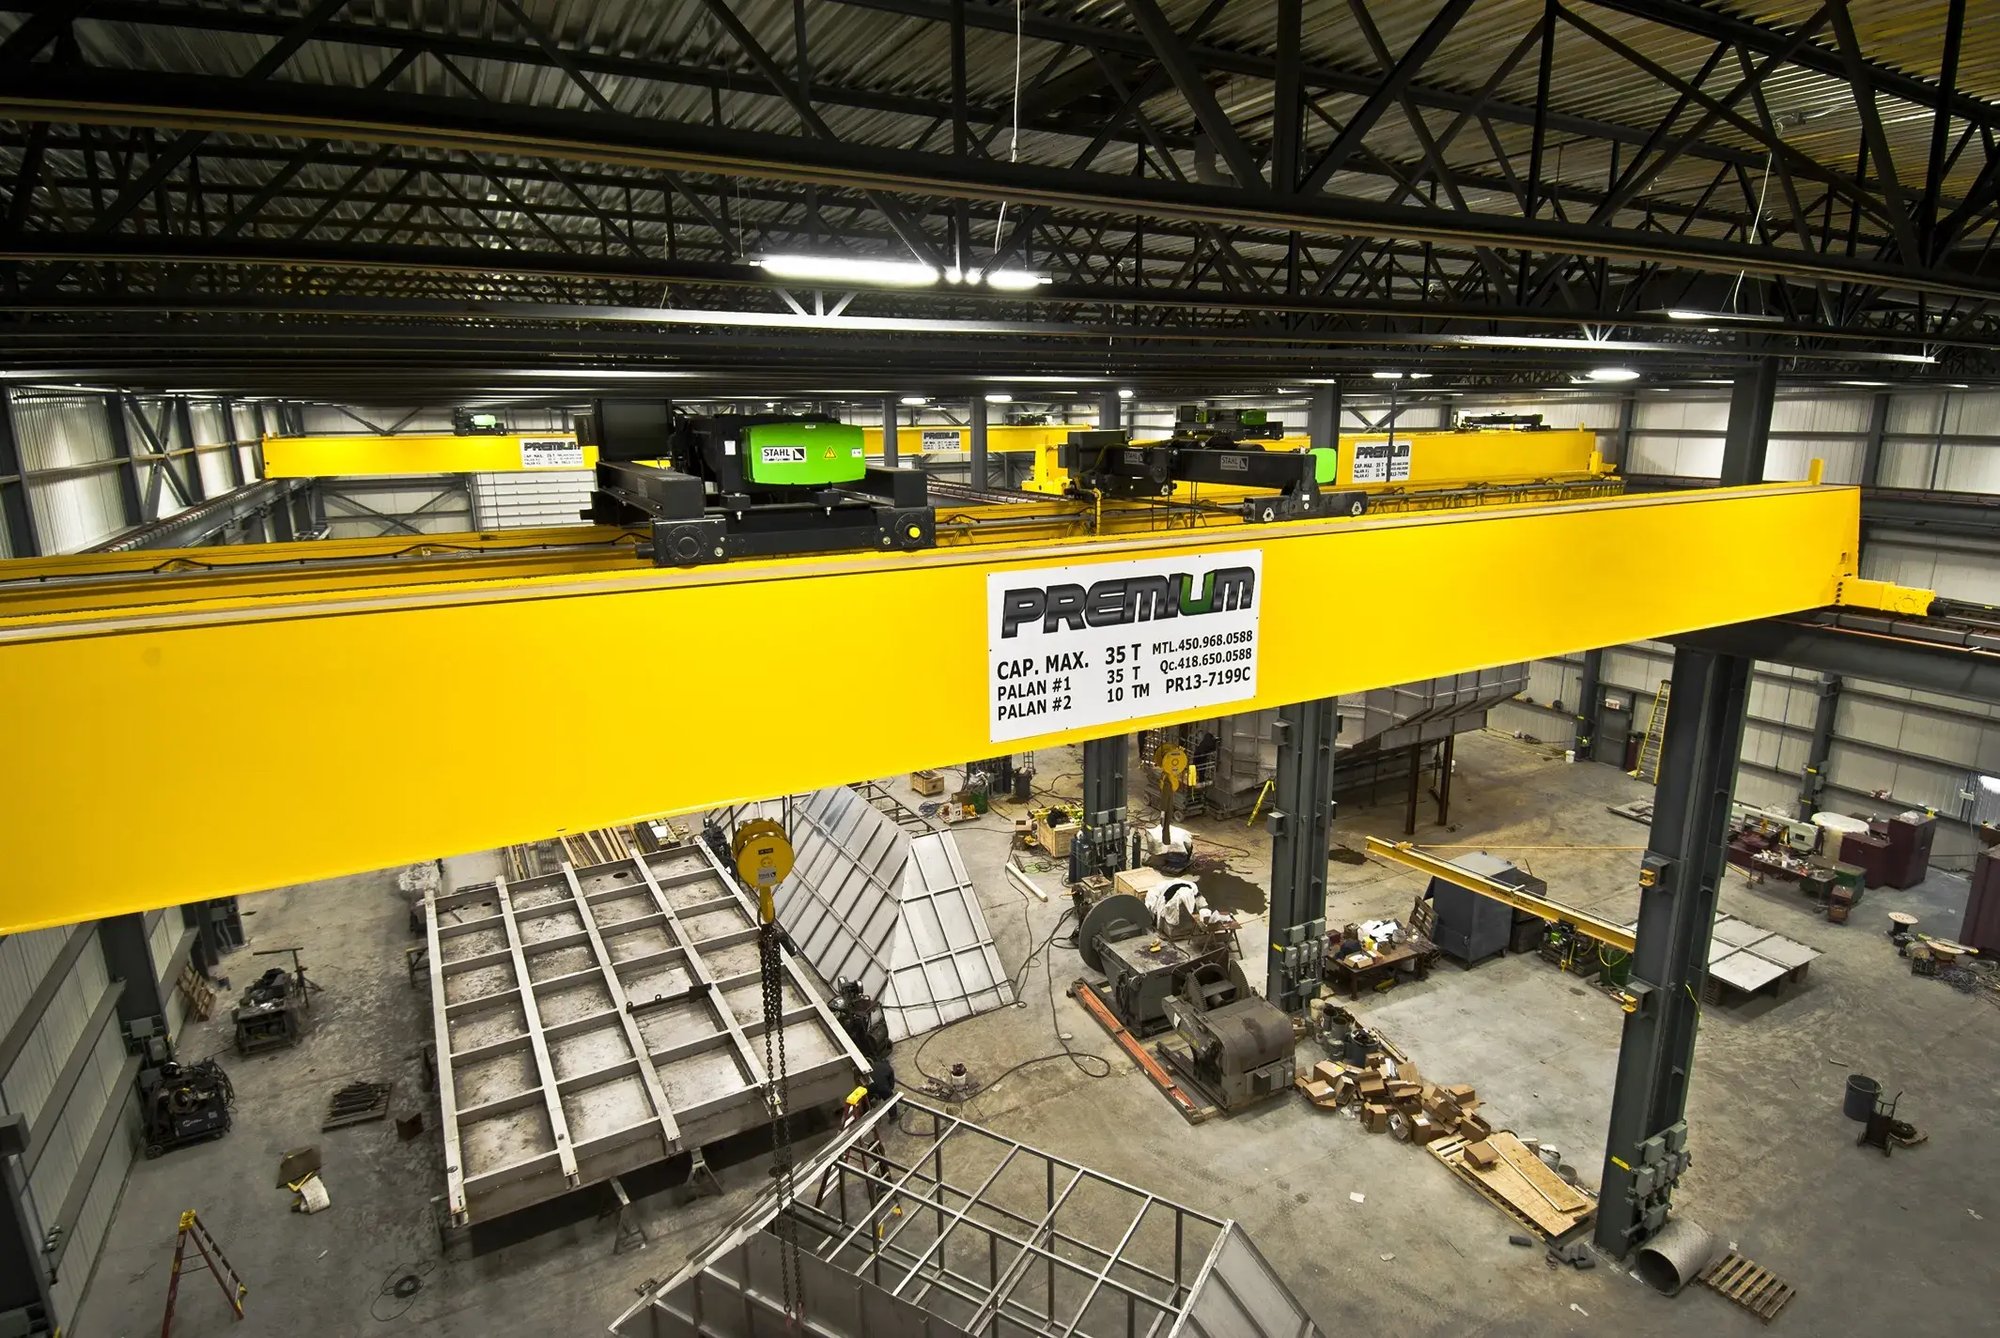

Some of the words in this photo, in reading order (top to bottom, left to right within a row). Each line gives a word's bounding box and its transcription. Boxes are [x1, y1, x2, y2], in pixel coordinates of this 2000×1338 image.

[763, 448, 791, 457] STAHL
[1001, 566, 1255, 639] PREMIUM
[1105, 645, 1126, 665] 35
[1131, 643, 1142, 661] T
[1152, 630, 1253, 655] MTL.450.968.0588
[997, 658, 1039, 681] CAP.
[1045, 651, 1089, 674] MAX.
[1160, 647, 1252, 674] Qc.418.650.0588
[1106, 668, 1124, 685] 35
[1132, 666, 1141, 681] T
[1165, 666, 1251, 694] PR13-7199C
[997, 679, 1047, 701] PALAN
[1052, 676, 1071, 693] #1
[1107, 687, 1124, 703] 10
[1131, 683, 1150, 699] TM
[998, 699, 1047, 721] PALAN
[1052, 695, 1072, 712] #2
